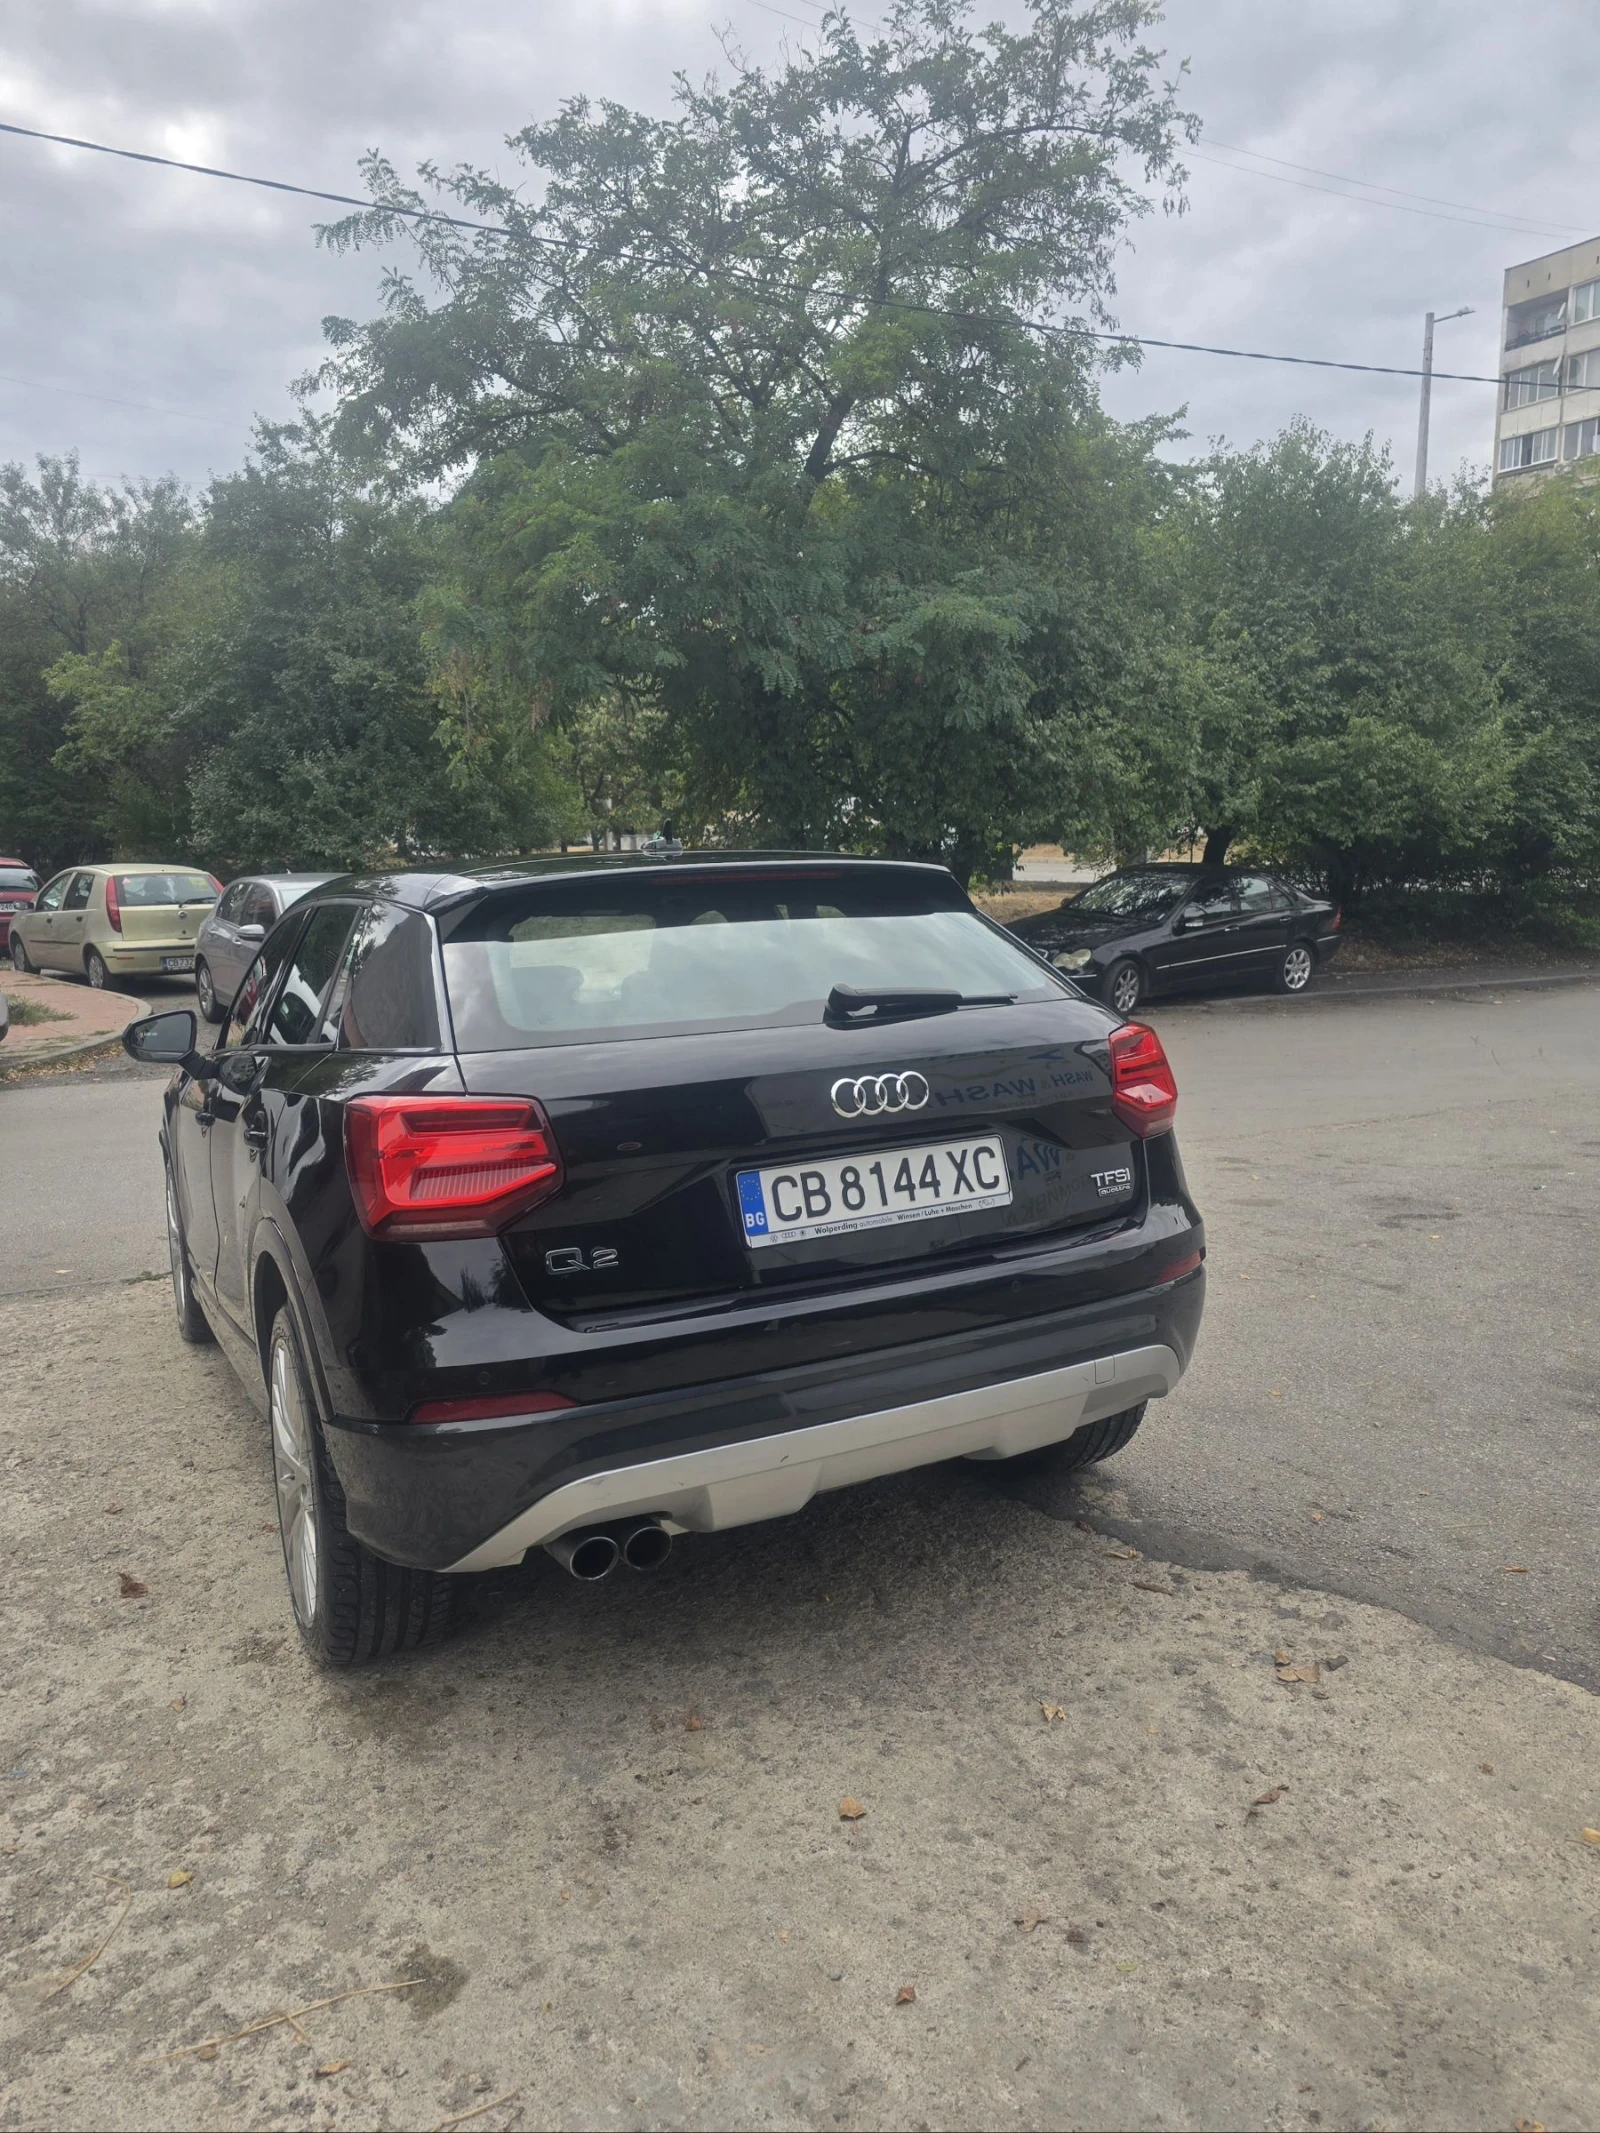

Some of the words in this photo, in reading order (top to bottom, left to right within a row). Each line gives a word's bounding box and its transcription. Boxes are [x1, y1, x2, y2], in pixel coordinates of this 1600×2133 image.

[771, 1170, 832, 1222] CB
[840, 1154, 941, 1211] 8144
[946, 1146, 1000, 1195] XC
[1090, 1167, 1131, 1187] TFSI
[1100, 1185, 1131, 1195] quattro
[745, 1212, 765, 1228] BG
[814, 1222, 858, 1236] Wolperding
[859, 1216, 893, 1228] automobile
[896, 1213, 920, 1221] Winsen
[924, 1208, 939, 1216] Luhe
